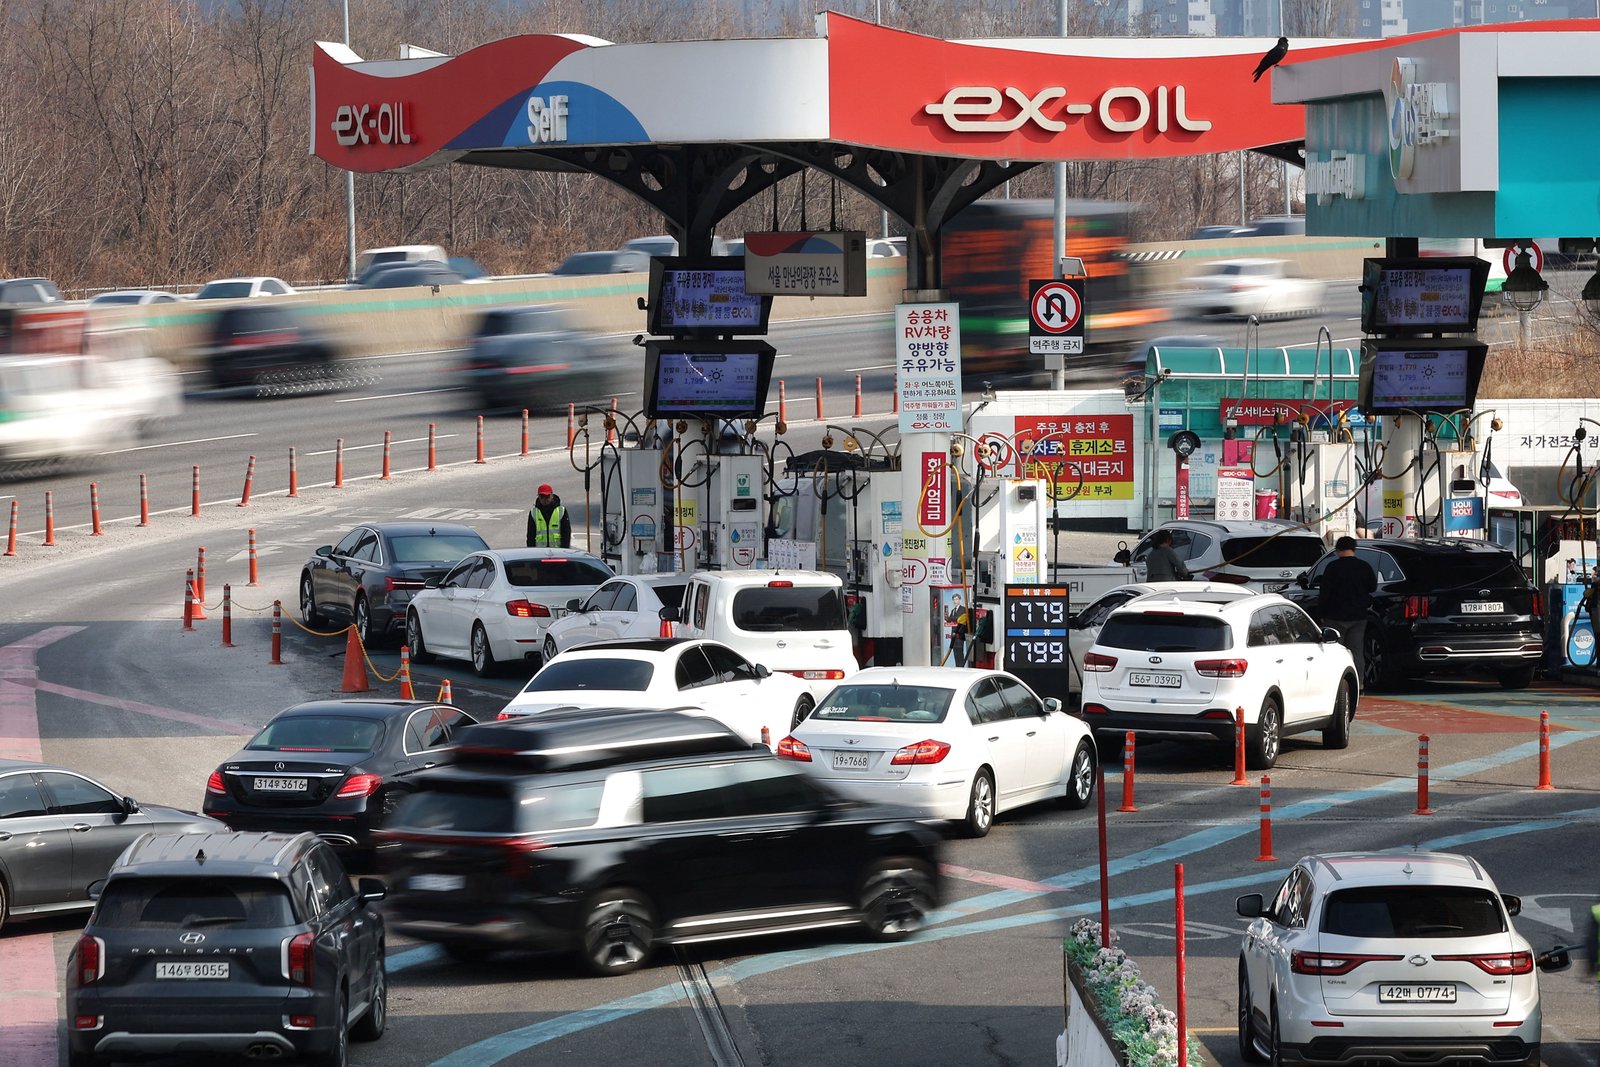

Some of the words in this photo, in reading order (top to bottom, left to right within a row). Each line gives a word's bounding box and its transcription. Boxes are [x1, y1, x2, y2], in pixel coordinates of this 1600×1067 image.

[768, 265, 781, 288] 서울
[783, 265, 816, 289] 만남의광장
[818, 266, 839, 286] 주유소
[907, 309, 948, 325] 승용차
[905, 325, 951, 340] RV차량
[908, 342, 949, 357] 양방향
[1032, 340, 1060, 350] 역주행
[1062, 340, 1081, 350] 금지
[902, 359, 956, 373] 주유가능
[921, 380, 954, 388] 어느쪽이든
[902, 390, 923, 398] 편하게
[924, 389, 956, 397] 주유하세요
[904, 401, 921, 410] 역주행
[915, 413, 928, 421] 정품
[933, 412, 945, 420] 정량
[1036, 422, 1058, 434] 주유
[1061, 422, 1071, 434] 및
[1075, 422, 1096, 434] 충전
[1098, 421, 1110, 433] 후
[1070, 439, 1128, 456] 휴게소로
[927, 457, 942, 520] 화기엄금
[1094, 485, 1113, 496] 부과
[1451, 507, 1472, 516] MOLY
[1383, 523, 1394, 535] elf
[902, 564, 917, 579] elf
[1010, 601, 1064, 623] 1779
[1484, 603, 1501, 611] 1807
[1010, 641, 1064, 663] 1799
[1154, 675, 1177, 685] 0390
[281, 779, 304, 789] 3616
[194, 964, 224, 976] 8055
[1386, 986, 1411, 998] 42머
[1417, 986, 1450, 998] 0774
